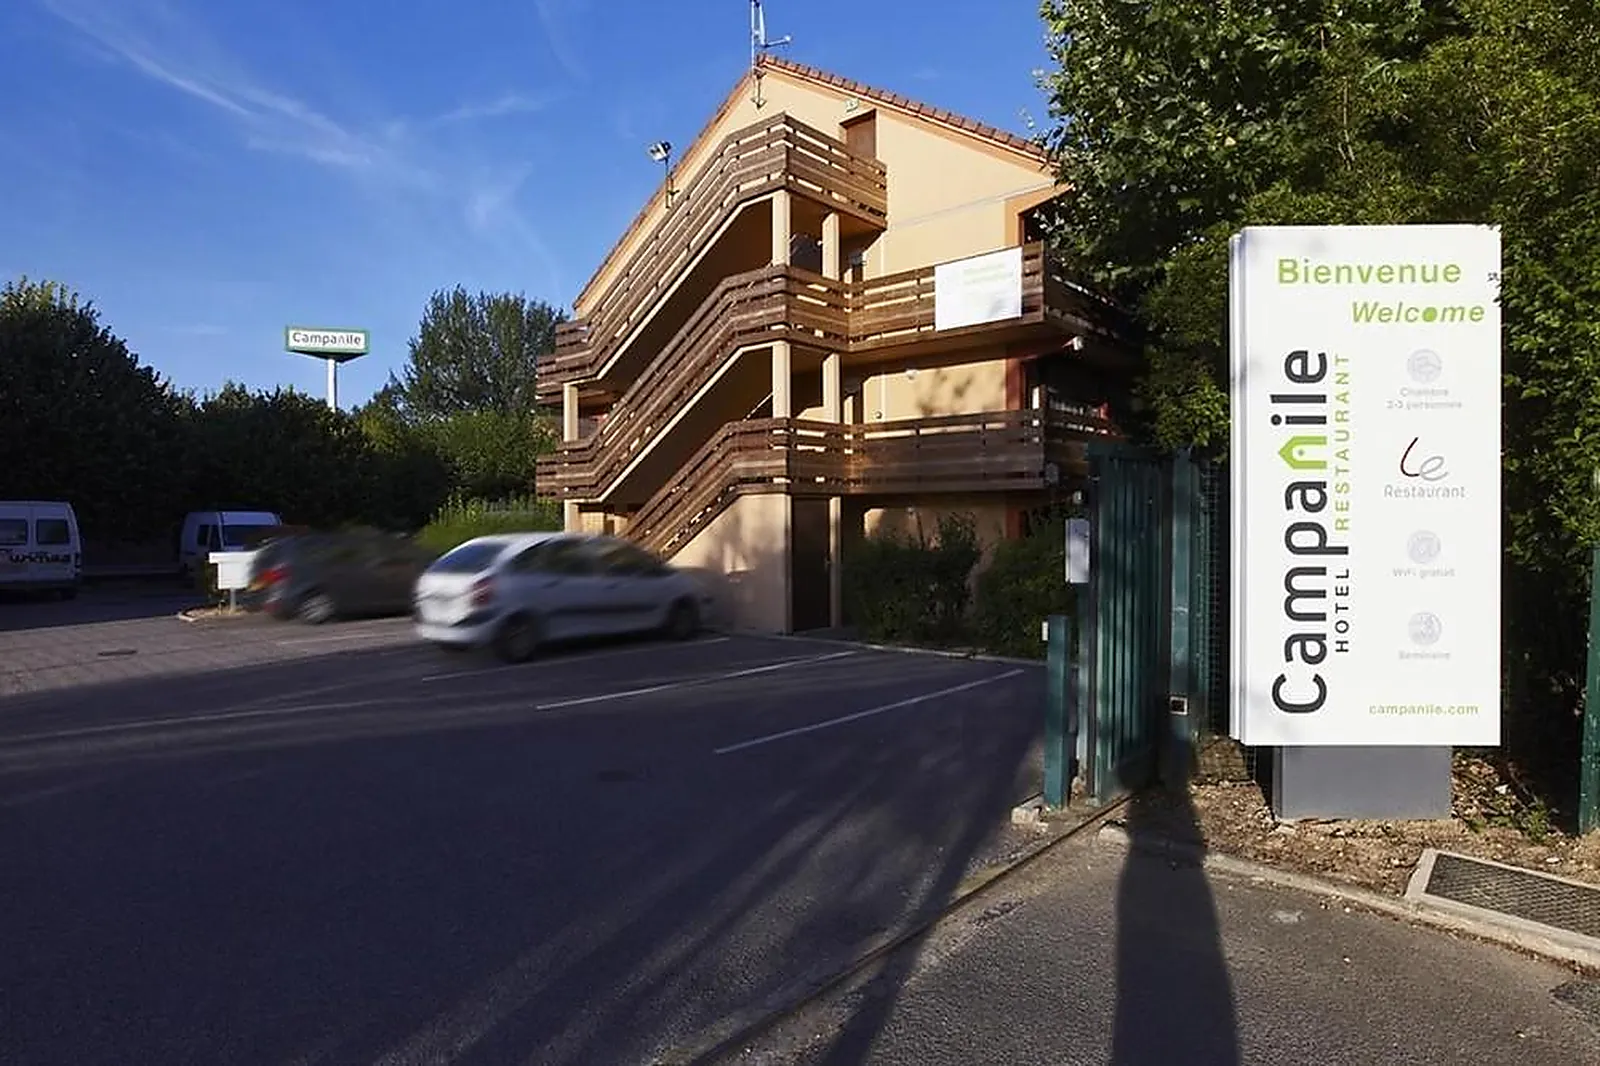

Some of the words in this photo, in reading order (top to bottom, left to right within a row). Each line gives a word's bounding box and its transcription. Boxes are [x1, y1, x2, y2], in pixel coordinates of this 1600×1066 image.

[1277, 258, 1462, 285] Bienvenue
[1352, 301, 1486, 324] Welcome
[292, 331, 362, 346] Campanile
[1334, 354, 1351, 532] RESTAURANT
[1384, 484, 1466, 498] Restaurant
[1269, 349, 1350, 714] Campanile
[1334, 568, 1350, 653] HOTEL
[1369, 703, 1479, 716] campanile.com
